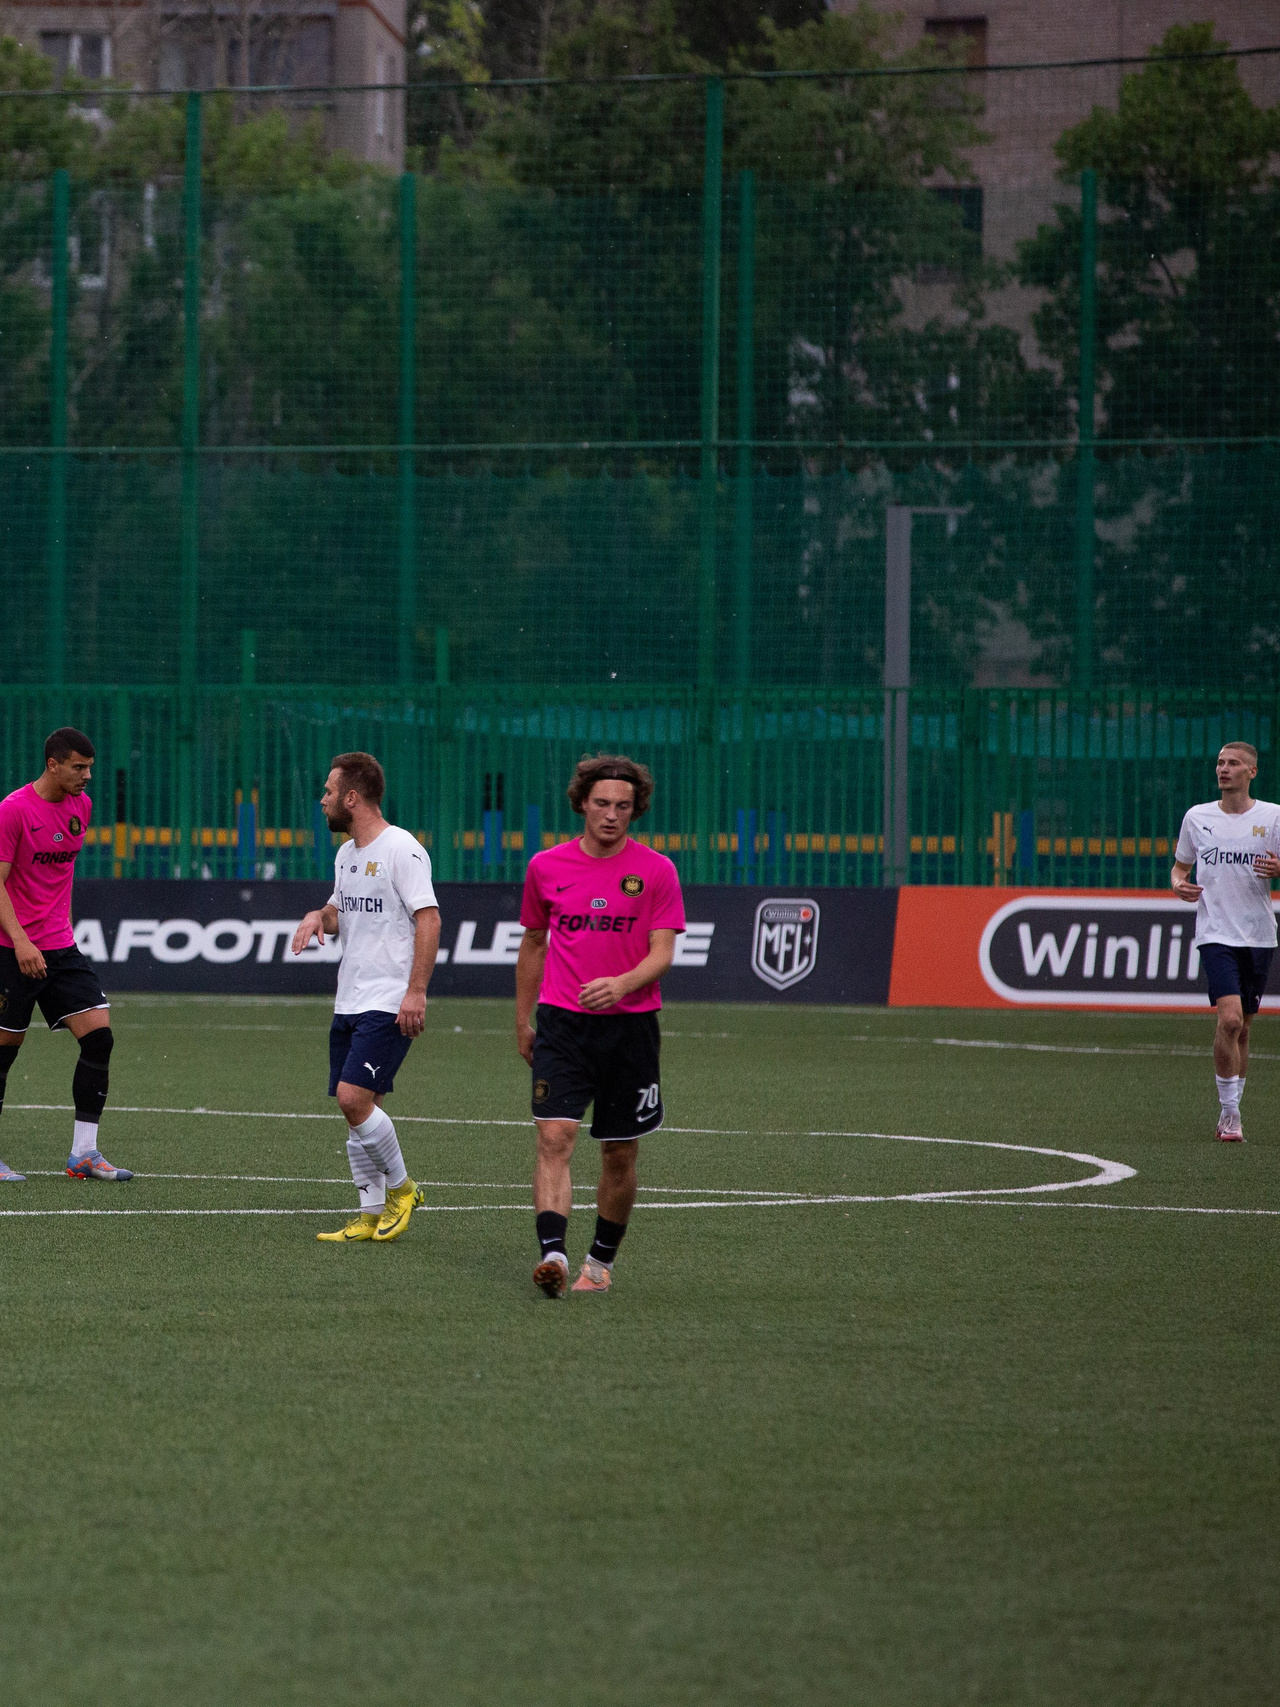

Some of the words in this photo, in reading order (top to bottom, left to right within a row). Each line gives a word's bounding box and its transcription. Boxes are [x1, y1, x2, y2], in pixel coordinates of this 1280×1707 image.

[31, 849, 80, 865] FONBE
[112, 918, 449, 963] FOOTB
[558, 914, 639, 934] FONBET
[758, 921, 810, 982] MFL
[1018, 922, 1201, 981] Winli
[635, 1083, 659, 1113] 70
